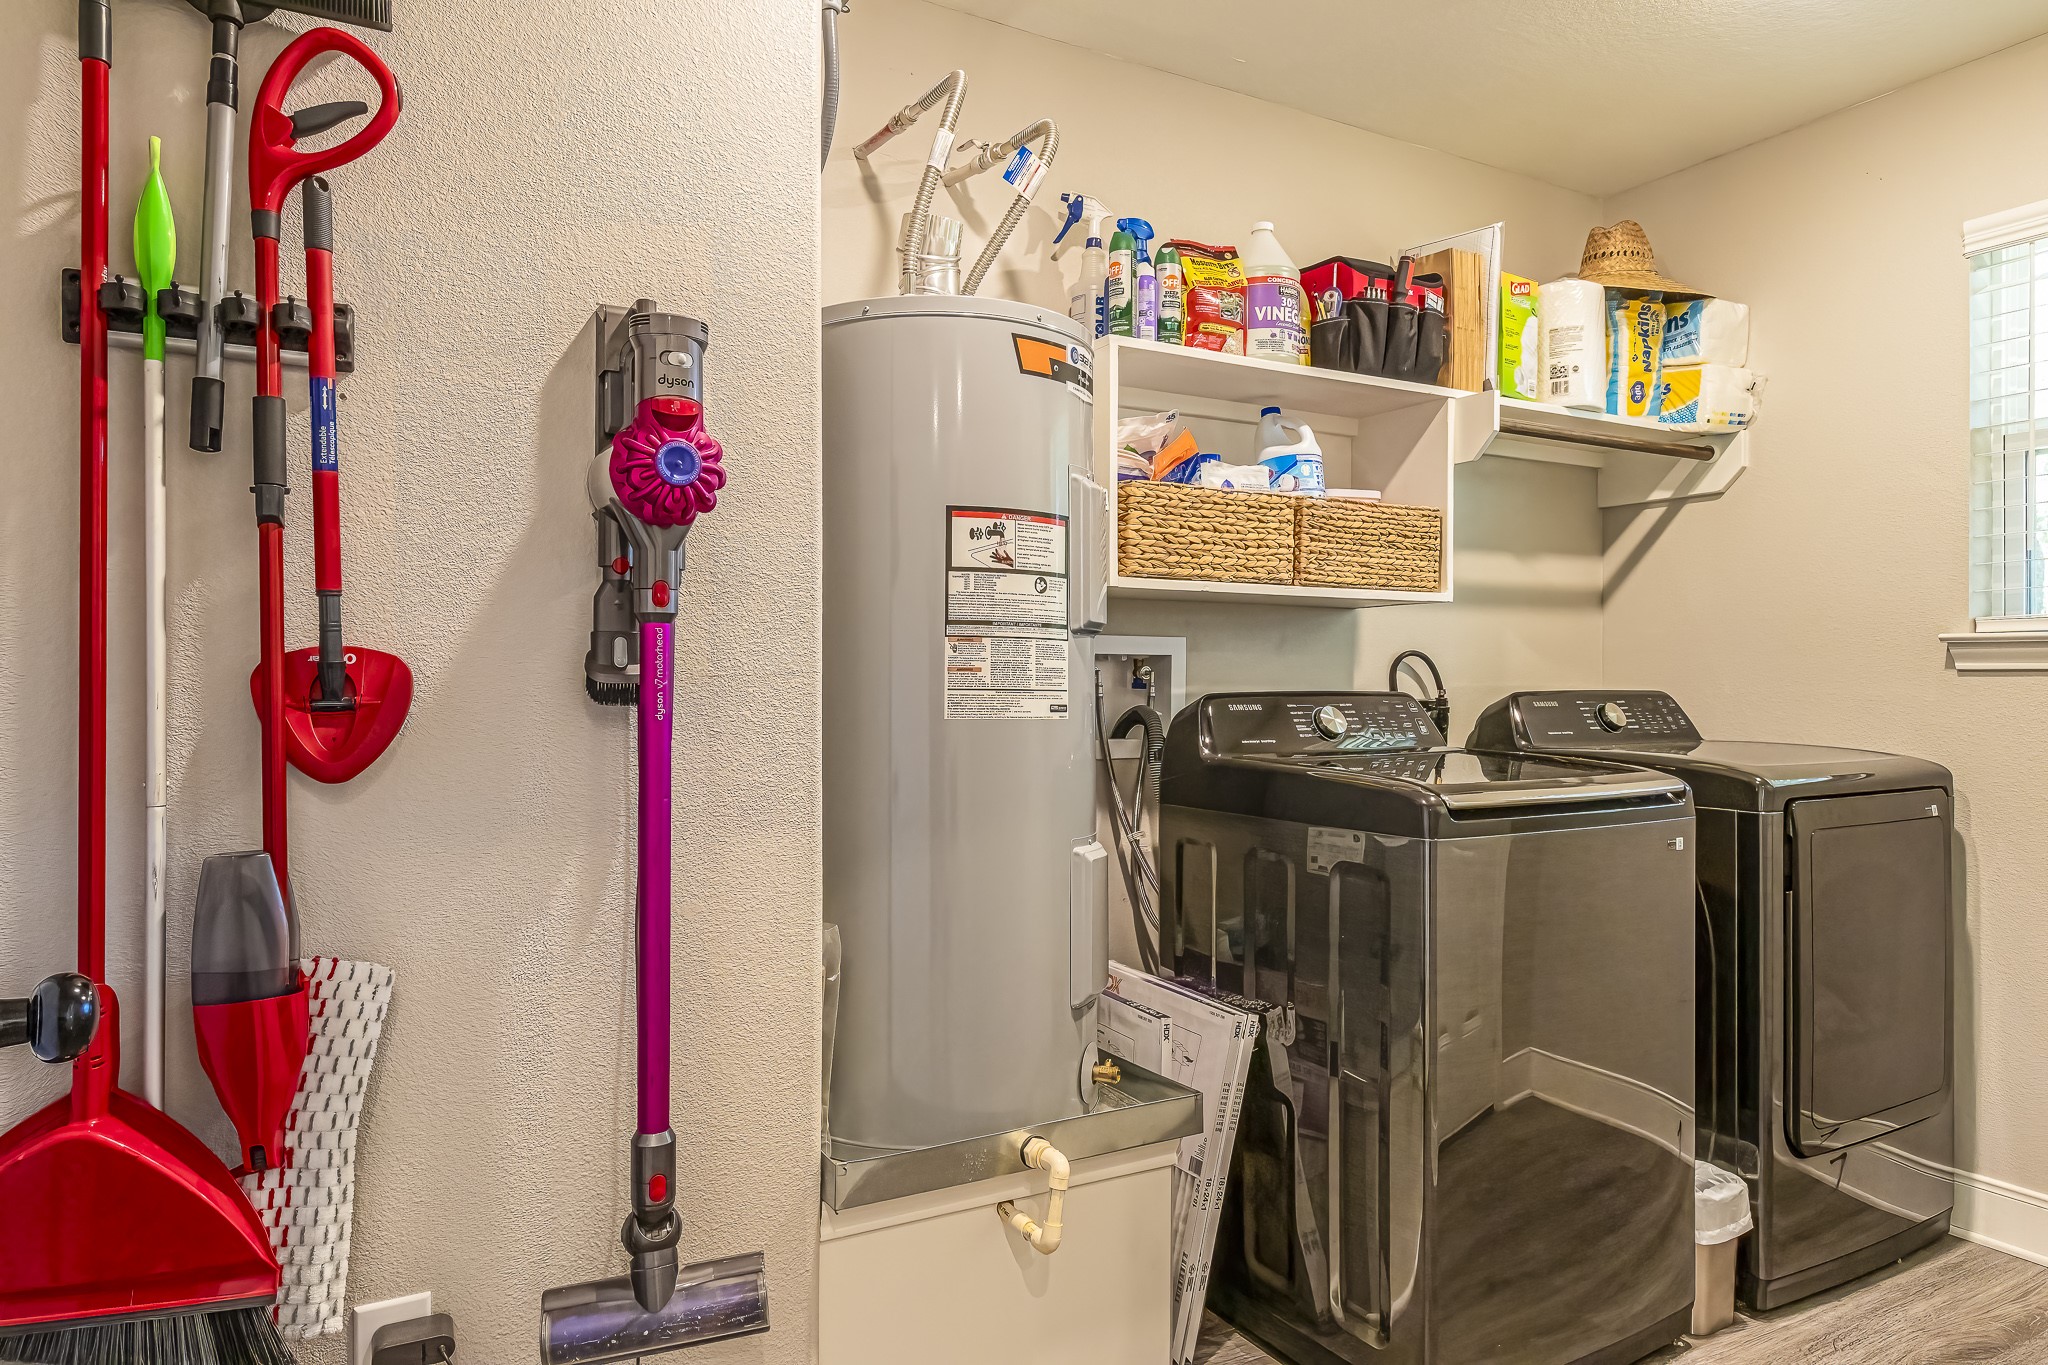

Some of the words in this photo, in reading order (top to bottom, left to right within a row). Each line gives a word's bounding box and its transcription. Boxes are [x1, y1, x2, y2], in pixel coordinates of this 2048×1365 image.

[1162, 279, 1180, 288] OFF!
[1511, 283, 1530, 295] GLAD
[1254, 306, 1300, 324] VINEG
[657, 374, 694, 388] dyson
[1633, 384, 1641, 401] 300
[319, 425, 327, 464] Extendable
[655, 627, 664, 678] motorhead
[655, 691, 666, 721] dyson
[1163, 1023, 1171, 1042] HDX
[1233, 1021, 1243, 1039] HDX
[1247, 1020, 1257, 1038] HDX
